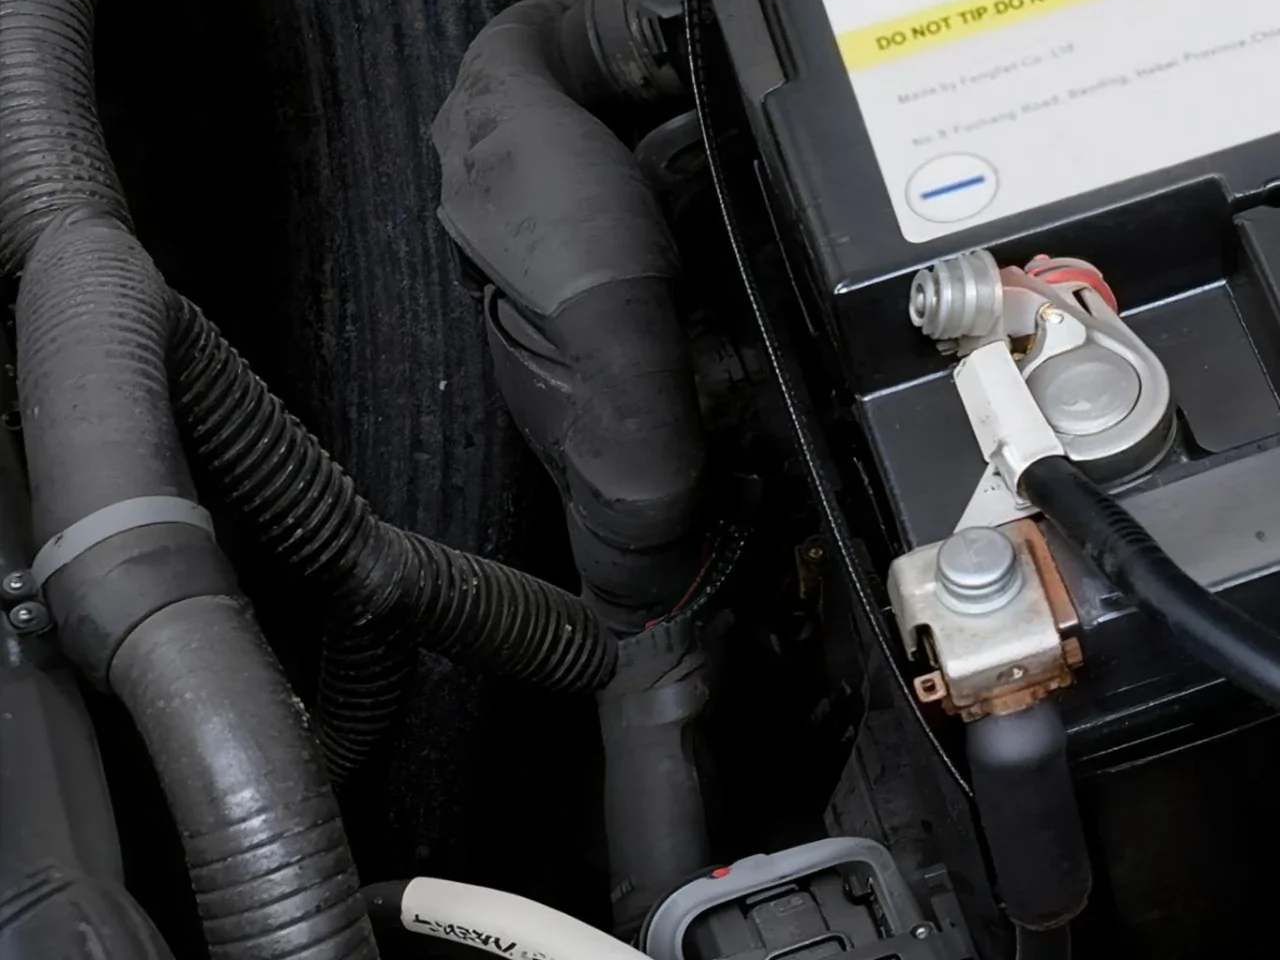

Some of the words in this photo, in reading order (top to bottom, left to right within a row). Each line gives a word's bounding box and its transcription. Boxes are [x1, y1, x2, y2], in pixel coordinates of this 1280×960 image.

[876, 31, 907, 50] DO
[911, 16, 952, 40] NOT
[957, 5, 989, 25] TIP
